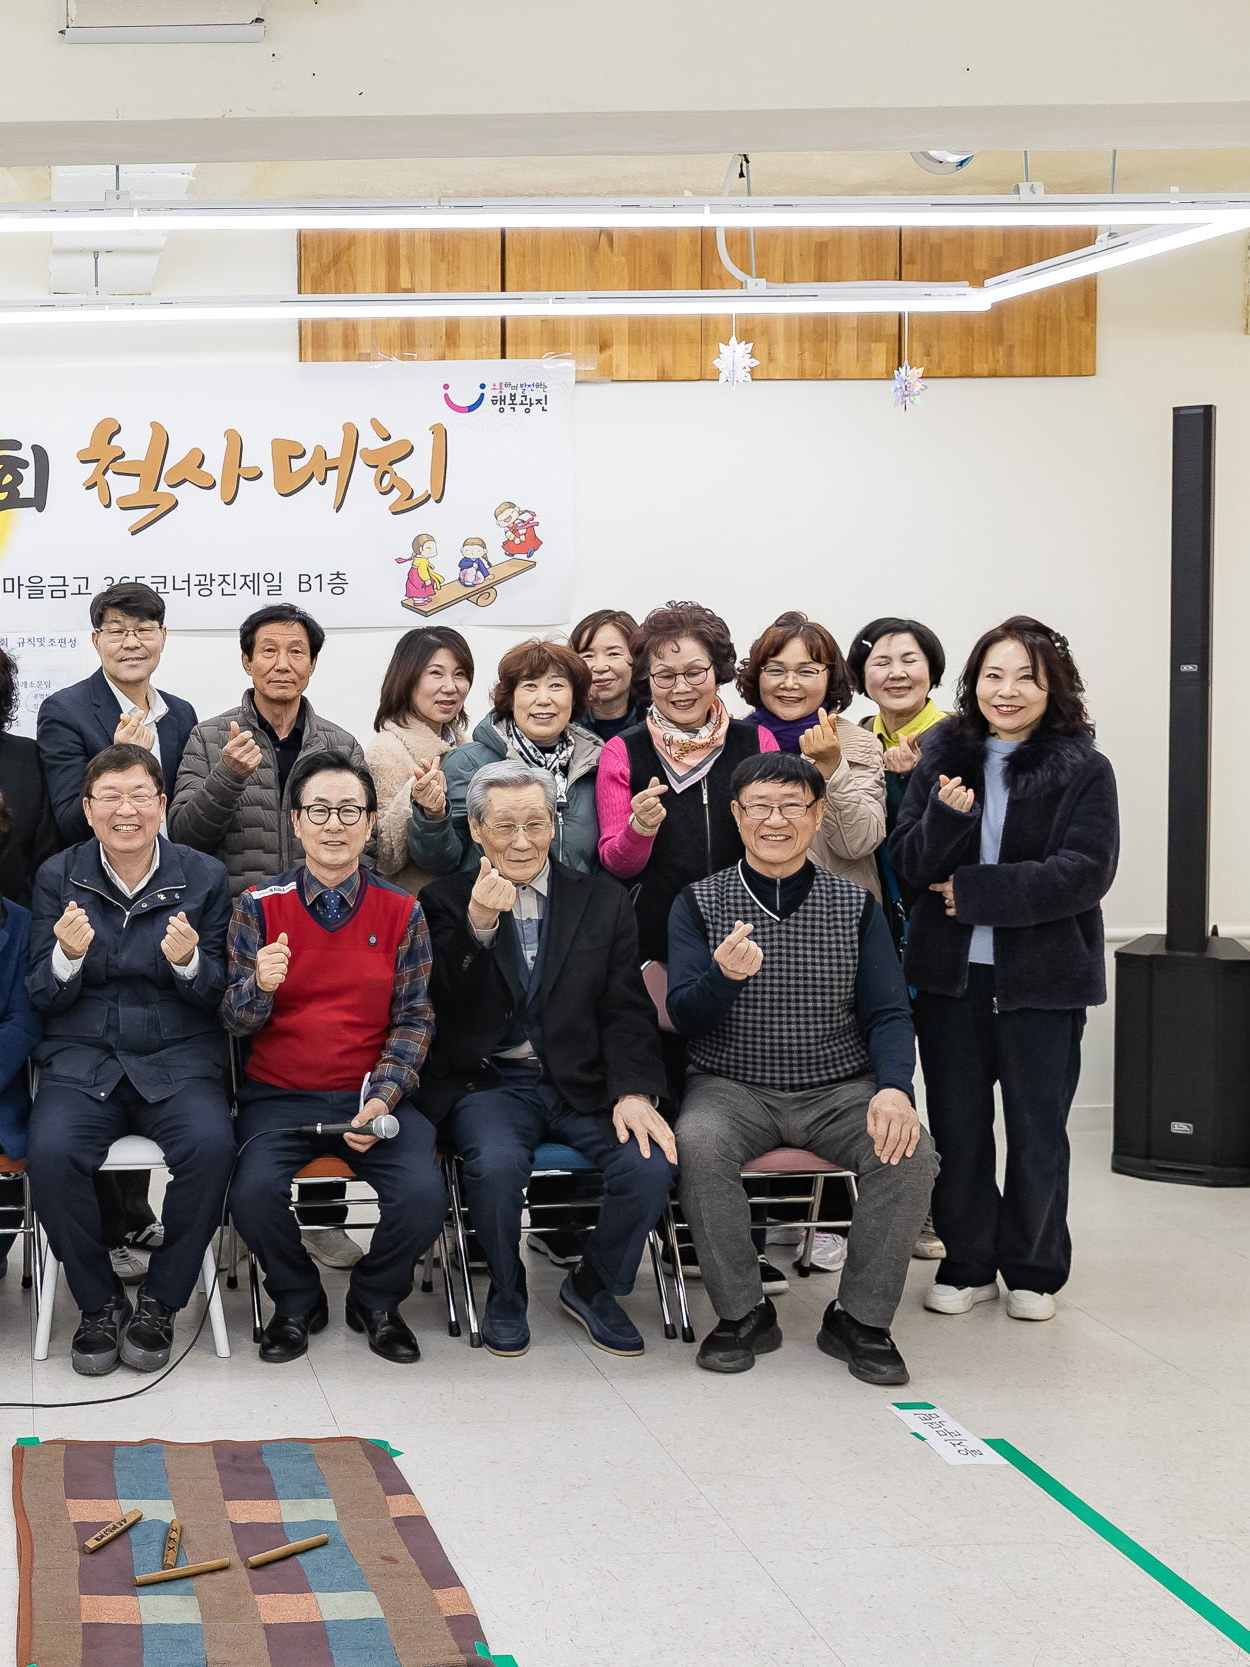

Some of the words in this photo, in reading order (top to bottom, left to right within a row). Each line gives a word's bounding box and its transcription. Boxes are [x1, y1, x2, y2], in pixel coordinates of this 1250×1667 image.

[491, 382, 518, 394] 소통하며
[520, 382, 547, 394] 발전하는
[491, 392, 547, 413] 행복광진
[77, 417, 448, 535] 척사대회
[298, 573, 349, 597] B1층
[17, 680, 51, 689] 개소문팀
[914, 1413, 983, 1458] 을지문덕팀
